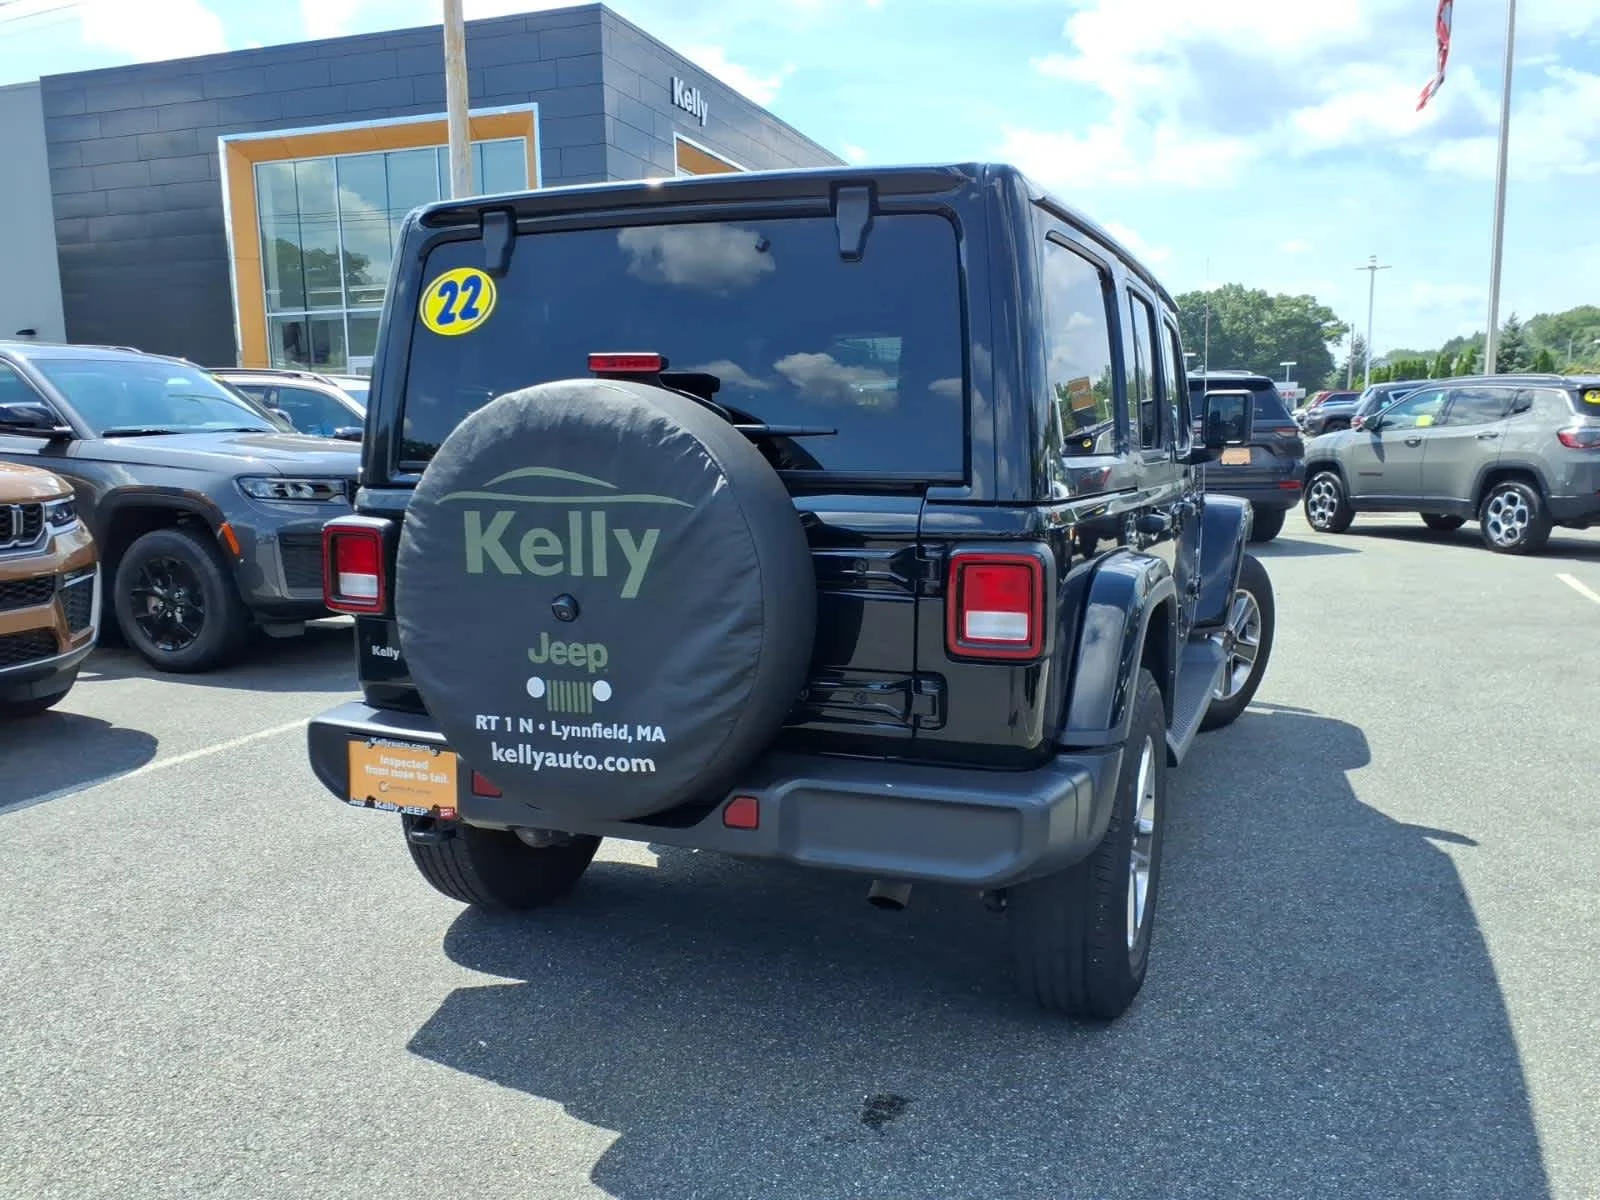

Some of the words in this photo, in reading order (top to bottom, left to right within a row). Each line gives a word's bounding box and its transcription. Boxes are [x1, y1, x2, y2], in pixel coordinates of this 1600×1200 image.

[672, 76, 708, 127] Kelly
[436, 274, 482, 326] 22
[462, 510, 661, 600] Kelly
[371, 645, 400, 661] Kelly
[527, 631, 609, 673] Jeep
[475, 714, 500, 731] RT
[504, 716, 513, 733] 1
[519, 717, 534, 734] N
[551, 720, 632, 744] Lynnfield,
[636, 724, 667, 743] MA
[491, 741, 657, 772] kellyauto.com
[374, 800, 400, 813] Kelly
[401, 806, 428, 816] JEEP
